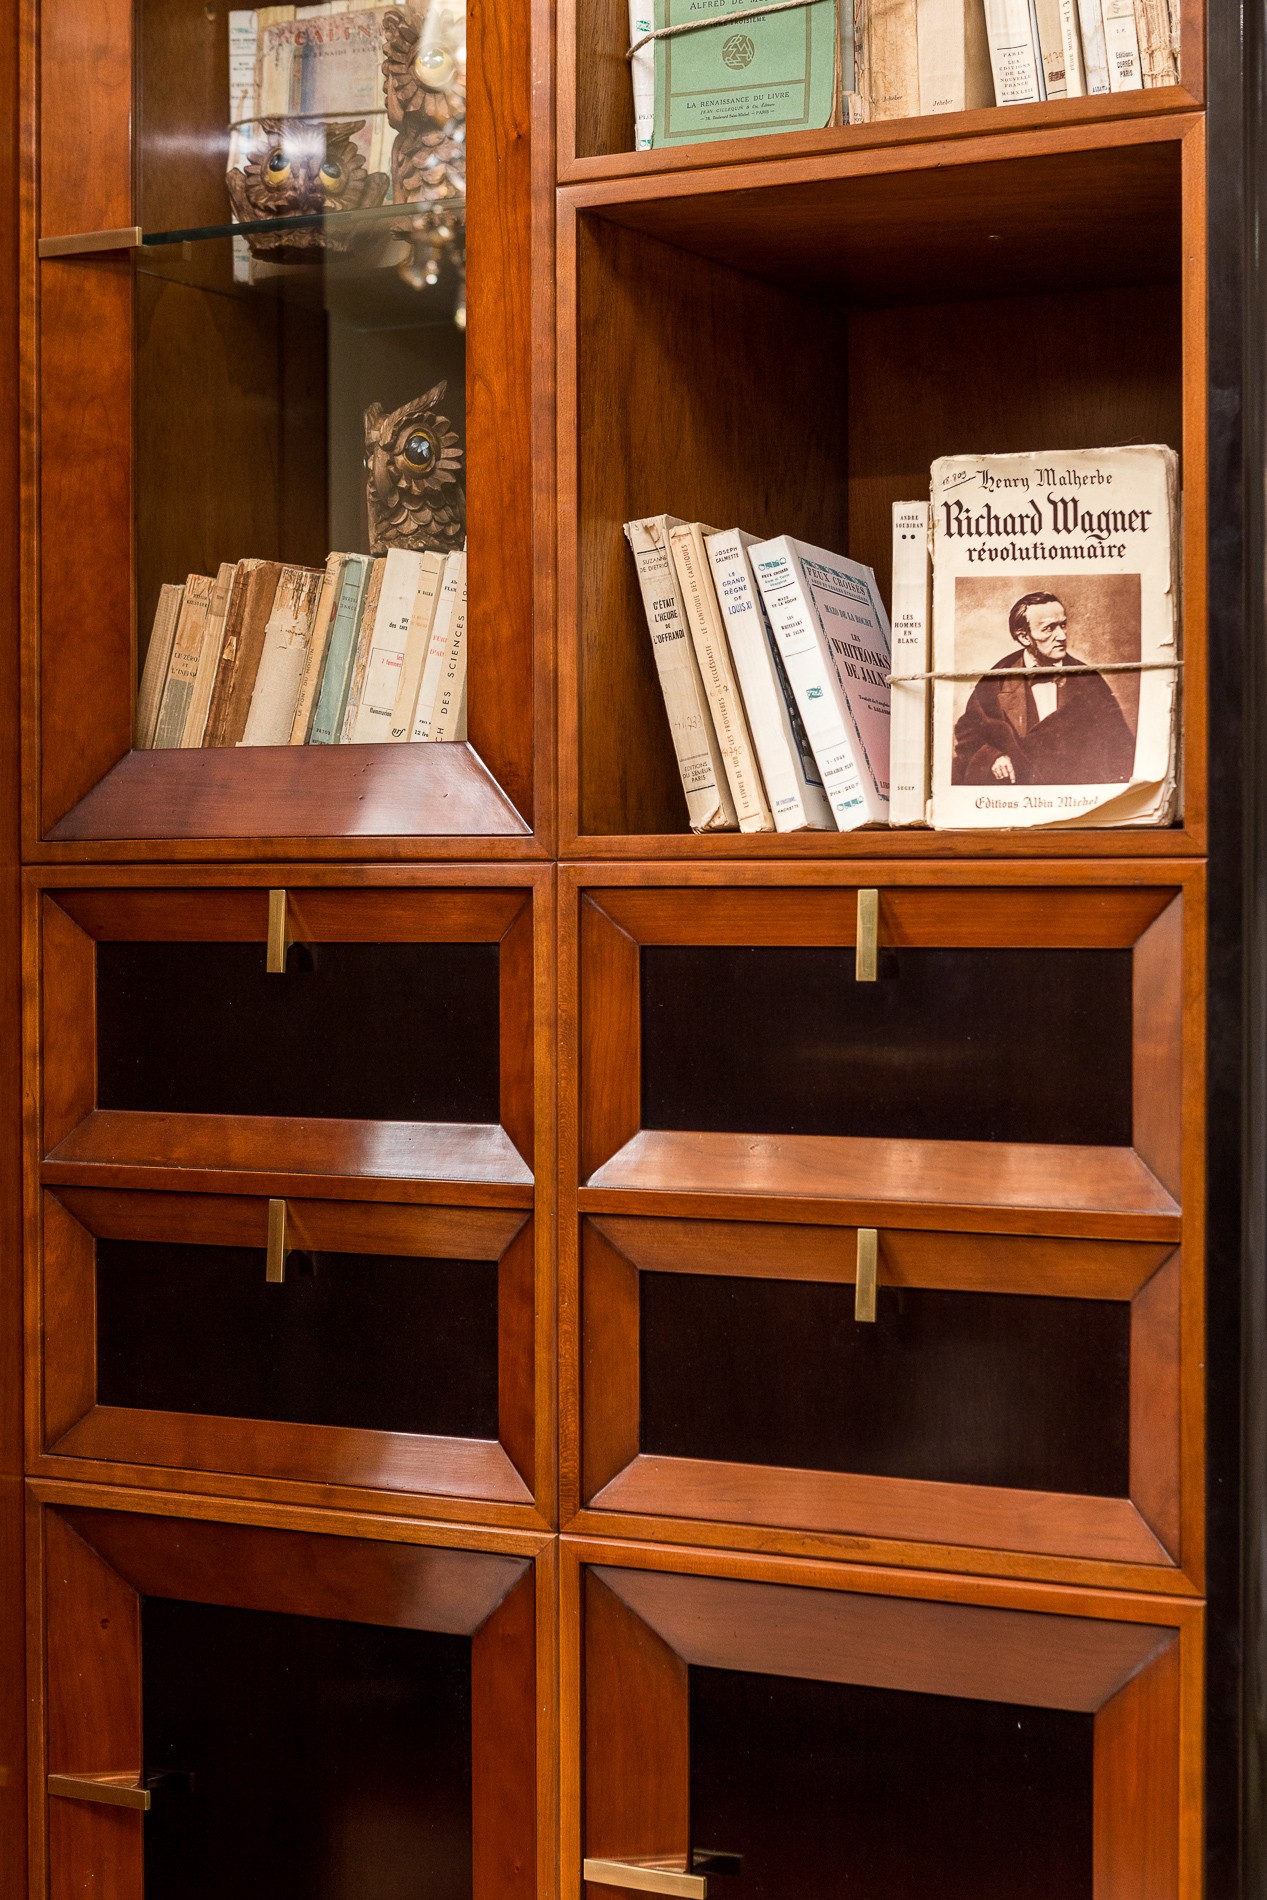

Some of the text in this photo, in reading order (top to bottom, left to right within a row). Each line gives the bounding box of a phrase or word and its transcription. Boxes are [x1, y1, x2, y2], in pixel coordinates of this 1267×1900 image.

[690, 0, 725, 10] ALFRED
[700, 96, 750, 108] RENAISSANCE
[767, 92, 790, 100] LIVRE
[975, 468, 1113, 493] Henry Malherbe
[941, 491, 1153, 541] Richard Wagner
[715, 547, 738, 557] JOSEPH
[715, 553, 739, 563] CALMETTE
[966, 541, 1127, 563] révolutionnaire
[681, 544, 695, 579] CANTIQUES
[806, 566, 830, 582] FEUX
[722, 576, 746, 587] GRAND
[724, 585, 747, 596] RÈGNE
[694, 594, 706, 626] CANTIQUE
[728, 601, 752, 615] LOUIS XI
[824, 604, 839, 615] MAZO
[839, 609, 848, 619] DE
[847, 611, 855, 622] LA
[654, 609, 678, 623] L'HEURE
[702, 627, 708, 635] LE
[851, 633, 861, 642] LES
[183, 653, 198, 662] ZÉRO
[831, 637, 891, 670] WHITEOAKS
[306, 648, 315, 674] MOULIN
[441, 691, 451, 714] DES
[448, 615, 465, 678] SCIENCES
[843, 661, 860, 679] DE
[304, 676, 309, 686] DU
[298, 708, 302, 716] LE
[718, 697, 731, 732] PROVERBES
[692, 775, 706, 784] PARIS
[736, 770, 742, 779] DE
[738, 780, 747, 800] LIVRE
[743, 801, 750, 809] LE
[1023, 796, 1053, 809] Albin
[1057, 796, 1099, 808] Michel
